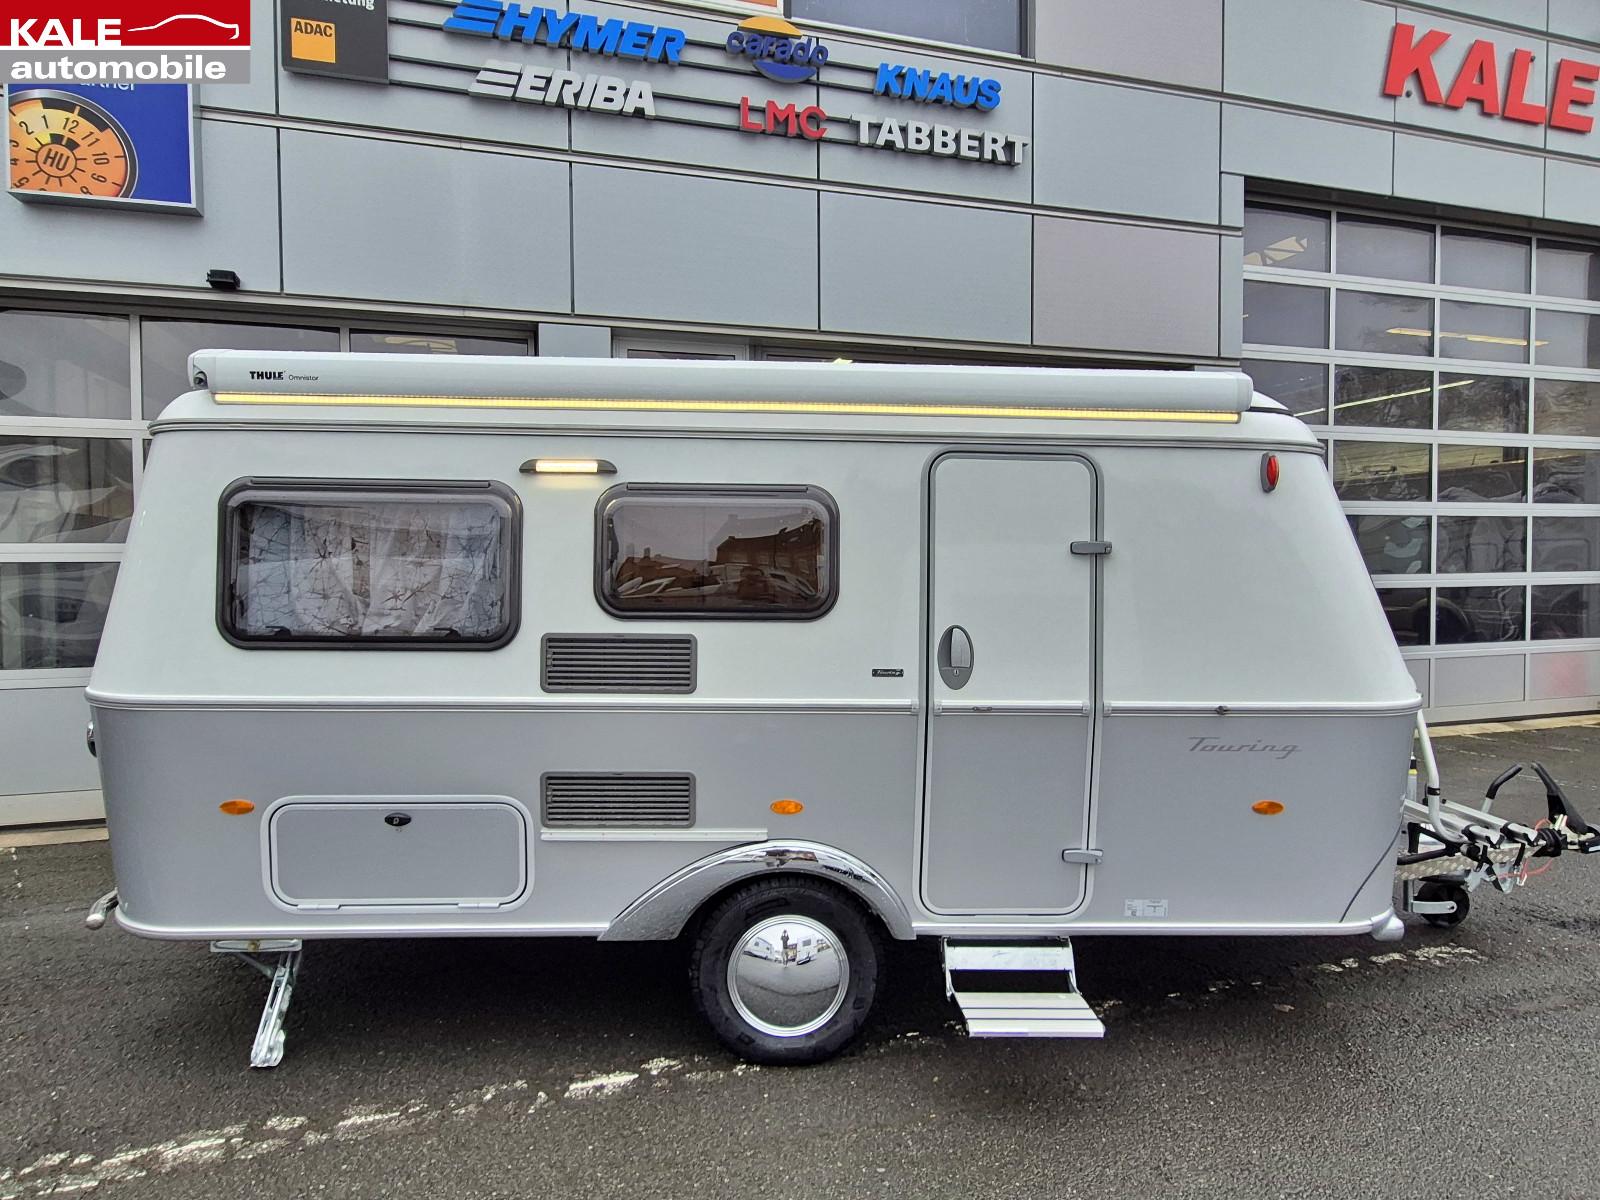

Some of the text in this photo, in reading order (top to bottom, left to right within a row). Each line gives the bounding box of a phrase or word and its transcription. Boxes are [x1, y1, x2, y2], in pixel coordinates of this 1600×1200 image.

[294, 20, 333, 38] ADAC
[498, 2, 687, 65] HYMER
[725, 31, 829, 67] carado
[874, 62, 1002, 111] KNAUS
[1382, 22, 1600, 134] KALE
[513, 64, 656, 119] ERIBA
[19, 120, 35, 136] 2
[41, 114, 49, 129] 1
[62, 117, 80, 134] 12
[739, 96, 828, 140] LMC
[81, 131, 101, 148] 11
[850, 112, 1030, 166] TABBERT
[43, 148, 70, 171] HU
[249, 370, 284, 380] THULE
[1187, 736, 1302, 760] Touring
